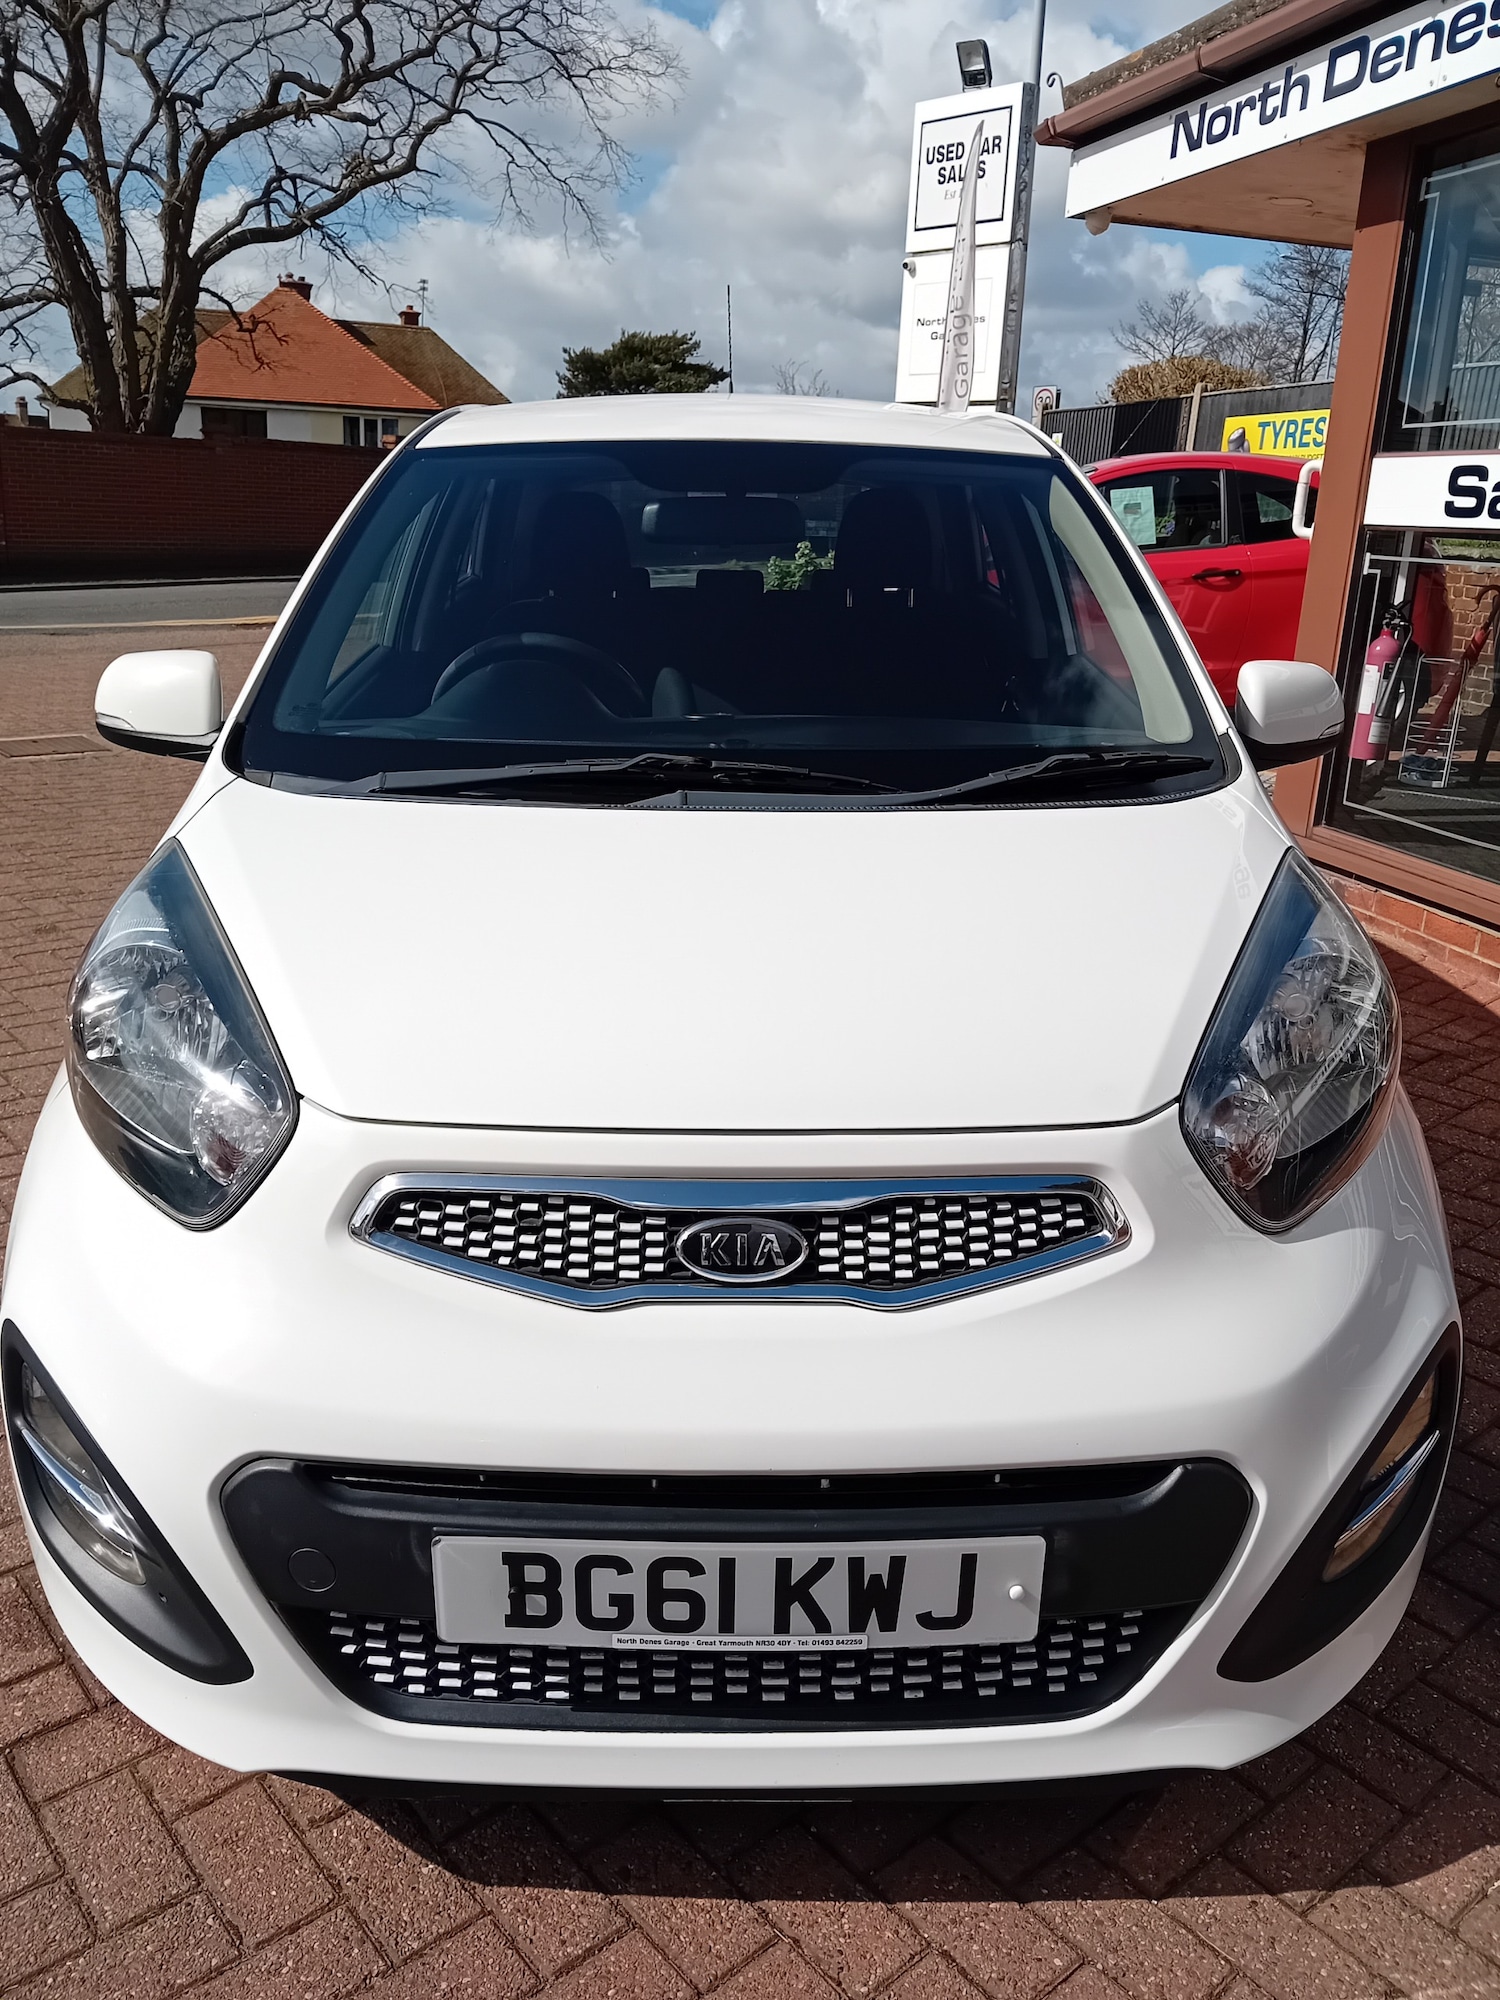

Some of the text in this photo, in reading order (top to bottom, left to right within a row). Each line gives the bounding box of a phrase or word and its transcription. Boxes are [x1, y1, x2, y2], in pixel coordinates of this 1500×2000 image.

[1169, 65, 1310, 160] North
[926, 135, 1002, 165] USED AR
[937, 160, 986, 185] SALS
[952, 295, 972, 398] Garage
[1258, 416, 1327, 450] TYRES
[700, 1233, 785, 1266] KIA
[501, 1552, 978, 1634] BG61 KWJ
[616, 1637, 637, 1645] North
[639, 1638, 662, 1646] Denes
[663, 1638, 690, 1647] Garage
[696, 1639, 716, 1647] Great
[718, 1639, 754, 1647] Yarmouth
[797, 1639, 810, 1647] Tel:
[811, 1638, 834, 1647] 01493
